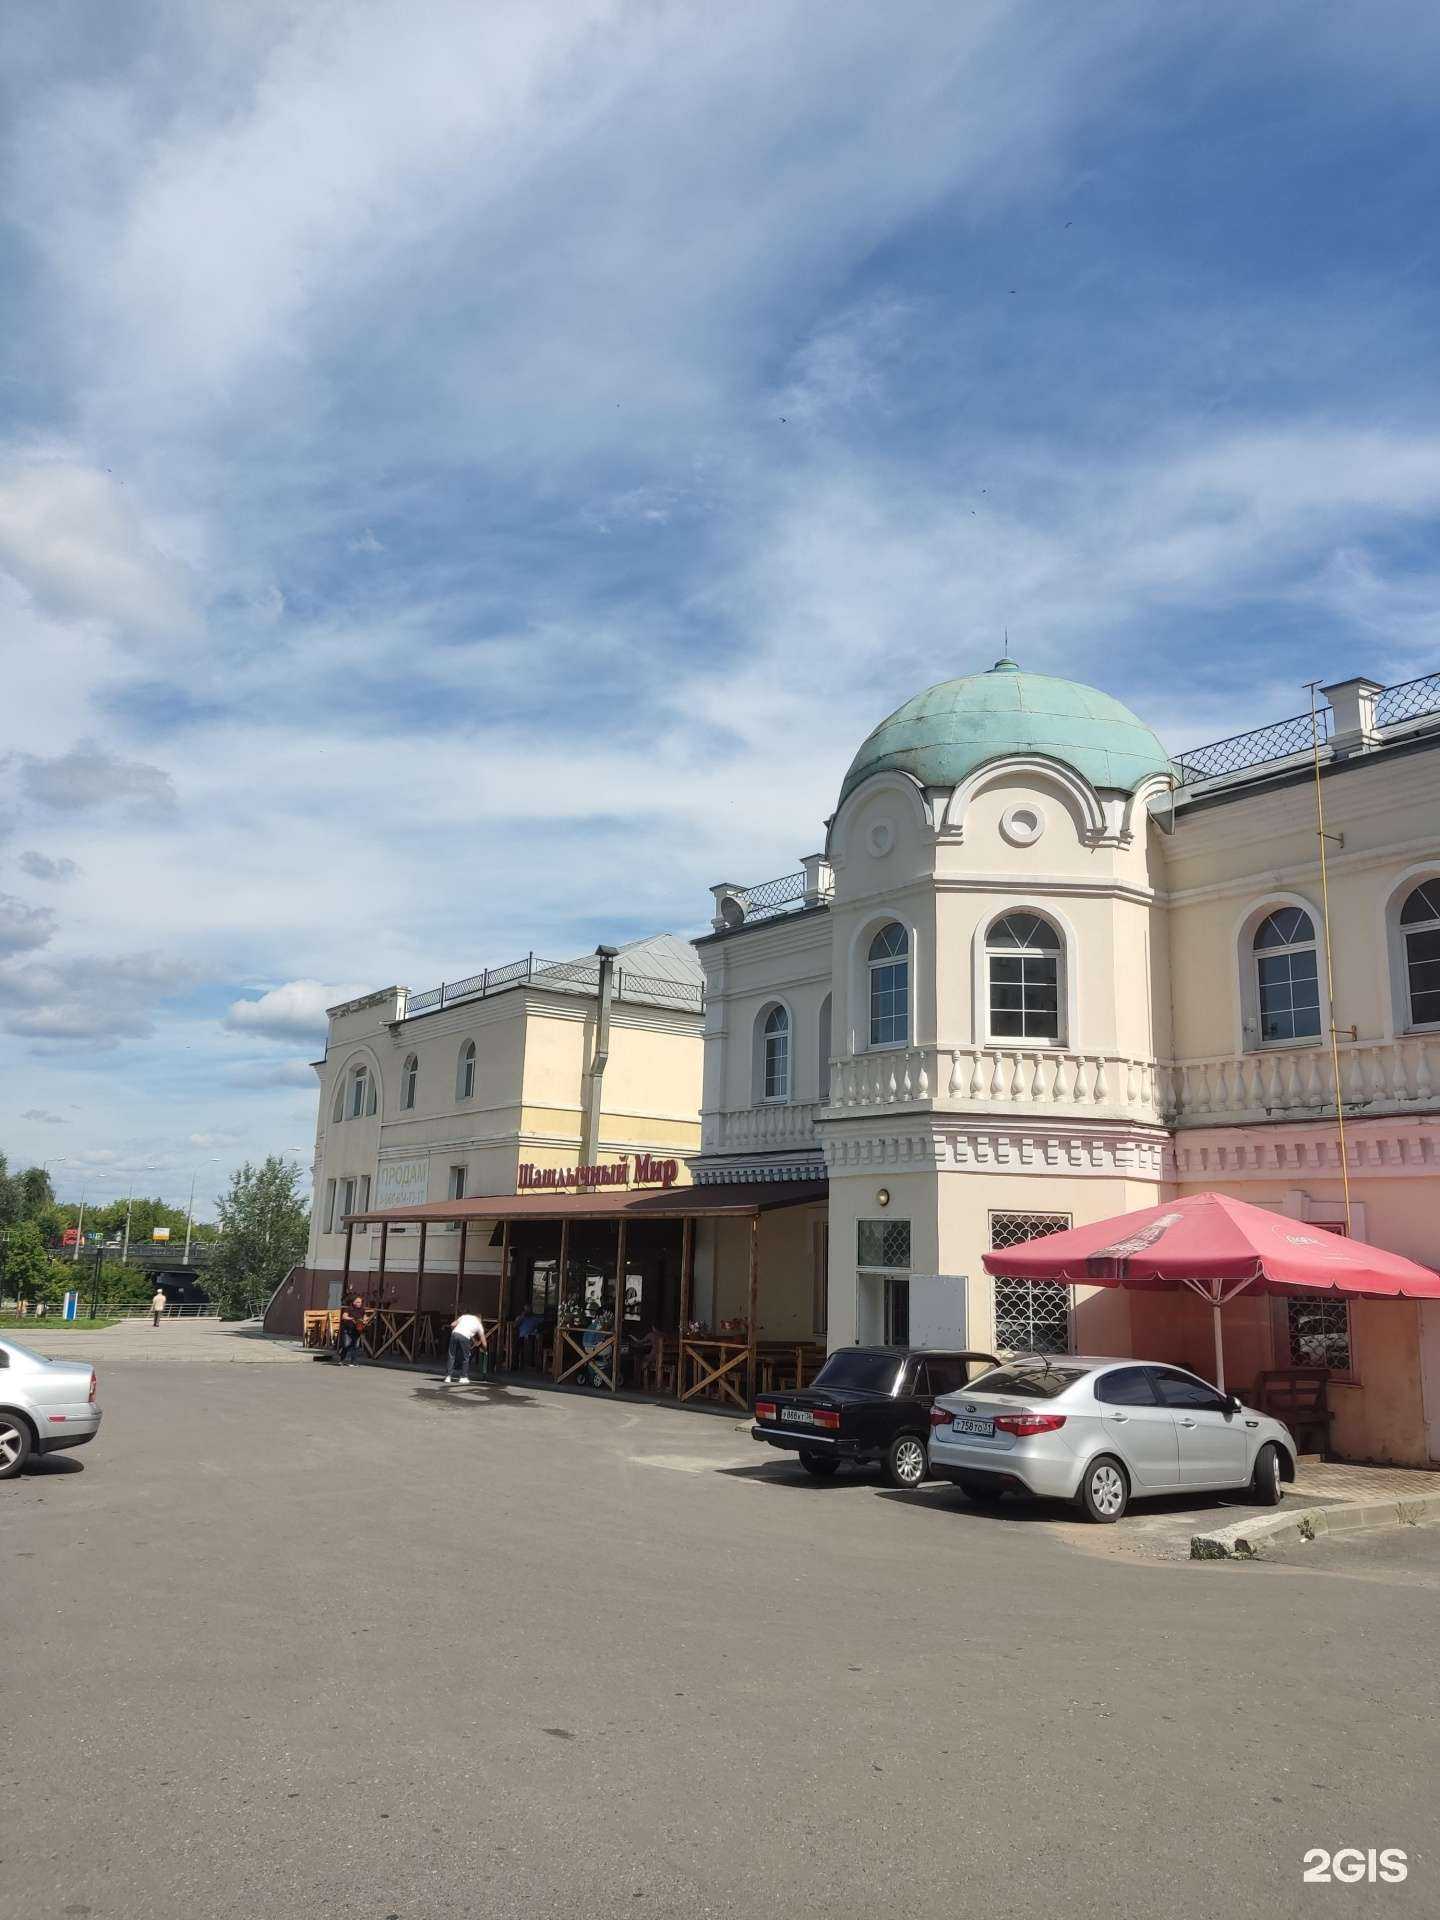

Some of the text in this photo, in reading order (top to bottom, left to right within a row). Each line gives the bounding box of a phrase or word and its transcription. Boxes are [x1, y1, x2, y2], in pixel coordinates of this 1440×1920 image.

[382, 1163, 428, 1186] ПРОДАМ
[518, 1153, 678, 1188] Шашлычный Мир
